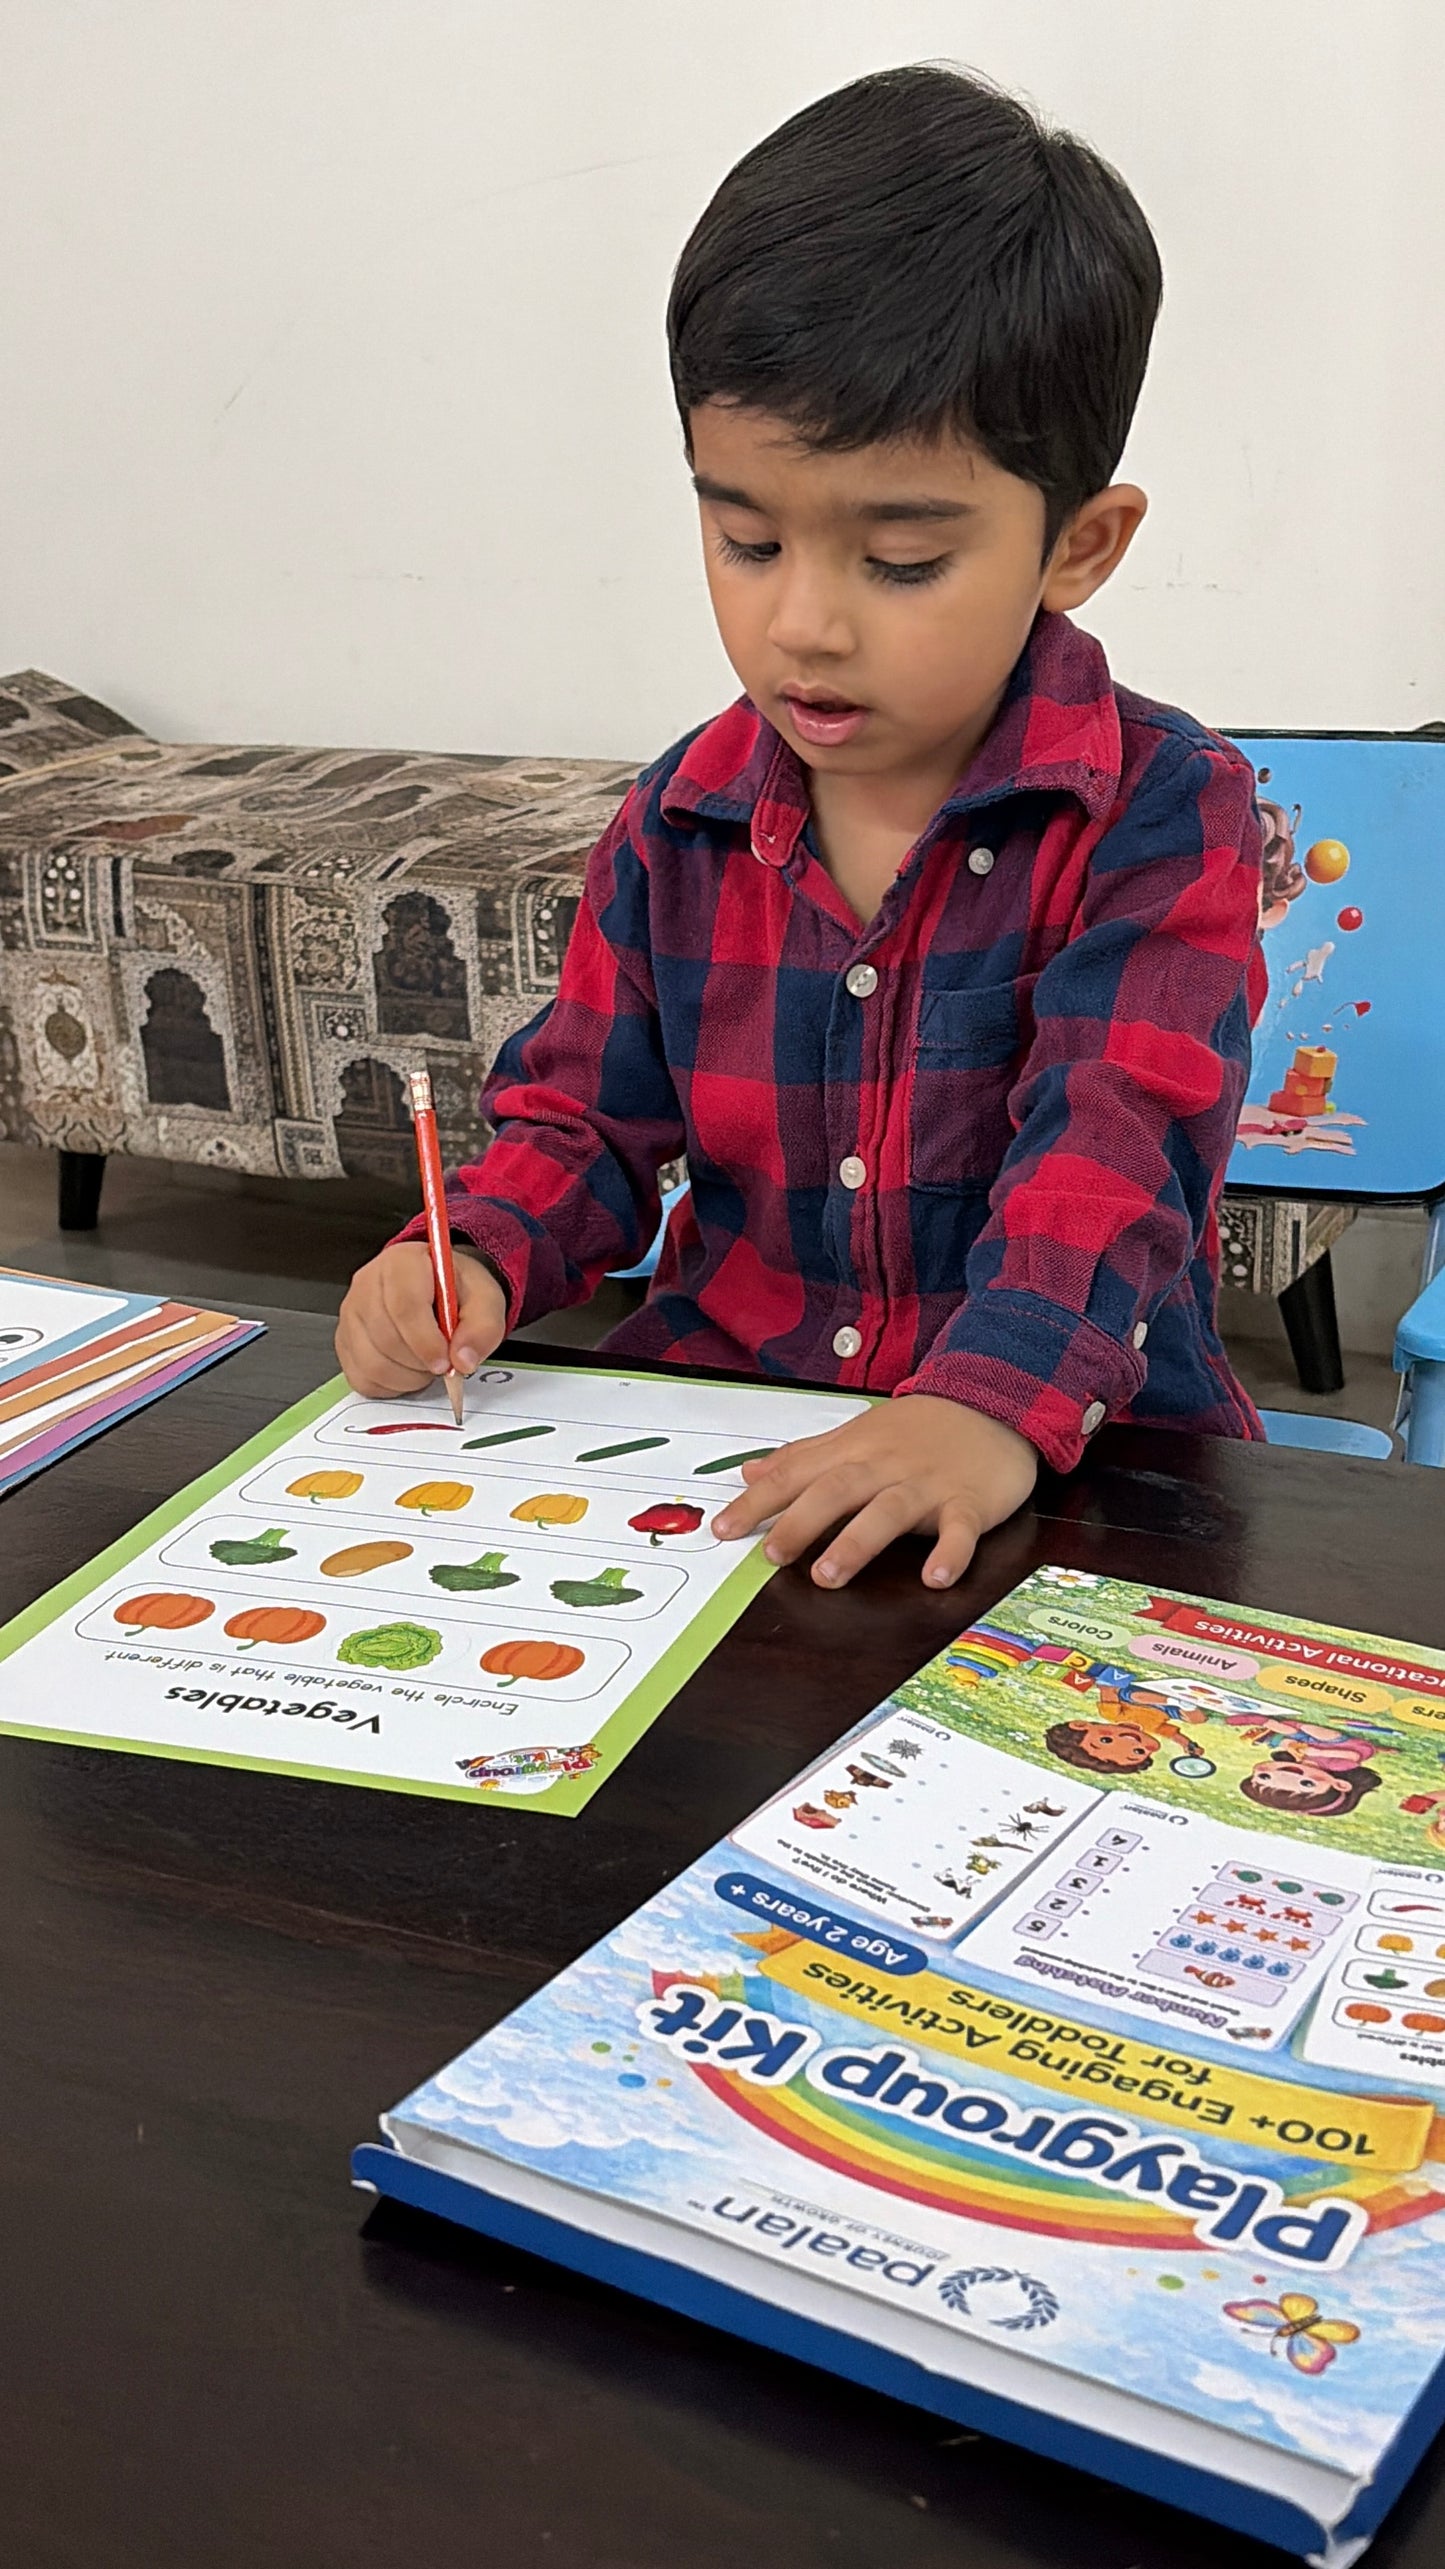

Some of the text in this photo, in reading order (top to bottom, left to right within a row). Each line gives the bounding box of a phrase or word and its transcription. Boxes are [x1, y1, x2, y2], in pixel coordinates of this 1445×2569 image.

[1048, 1615, 1113, 1641] Colors
[1195, 1620, 1323, 1660] Activities
[208, 1661, 226, 1674] is
[1152, 1642, 1238, 1671] Animals
[230, 1666, 276, 1681] that
[284, 1672, 383, 1693] vegetable
[391, 1688, 425, 1702] the
[1284, 1675, 1367, 1704] Shapes
[164, 1686, 381, 1734] Vegetables
[434, 1693, 519, 1715] Encircle
[1111, 1835, 1127, 1846] 4
[1093, 1856, 1108, 1867] 1
[1069, 1877, 1087, 1889] 3
[1050, 1898, 1068, 1910] 2
[730, 1884, 910, 1967] Age 2 years +
[1027, 1920, 1046, 1932] 5
[1014, 1955, 1228, 2028] Number Matching
[948, 1989, 1213, 2086] for Toddlers
[802, 1961, 1377, 2156] 100+ Engaging Activities
[650, 1991, 1351, 2263] Playgroup Kit
[712, 2196, 935, 2287] paalan
